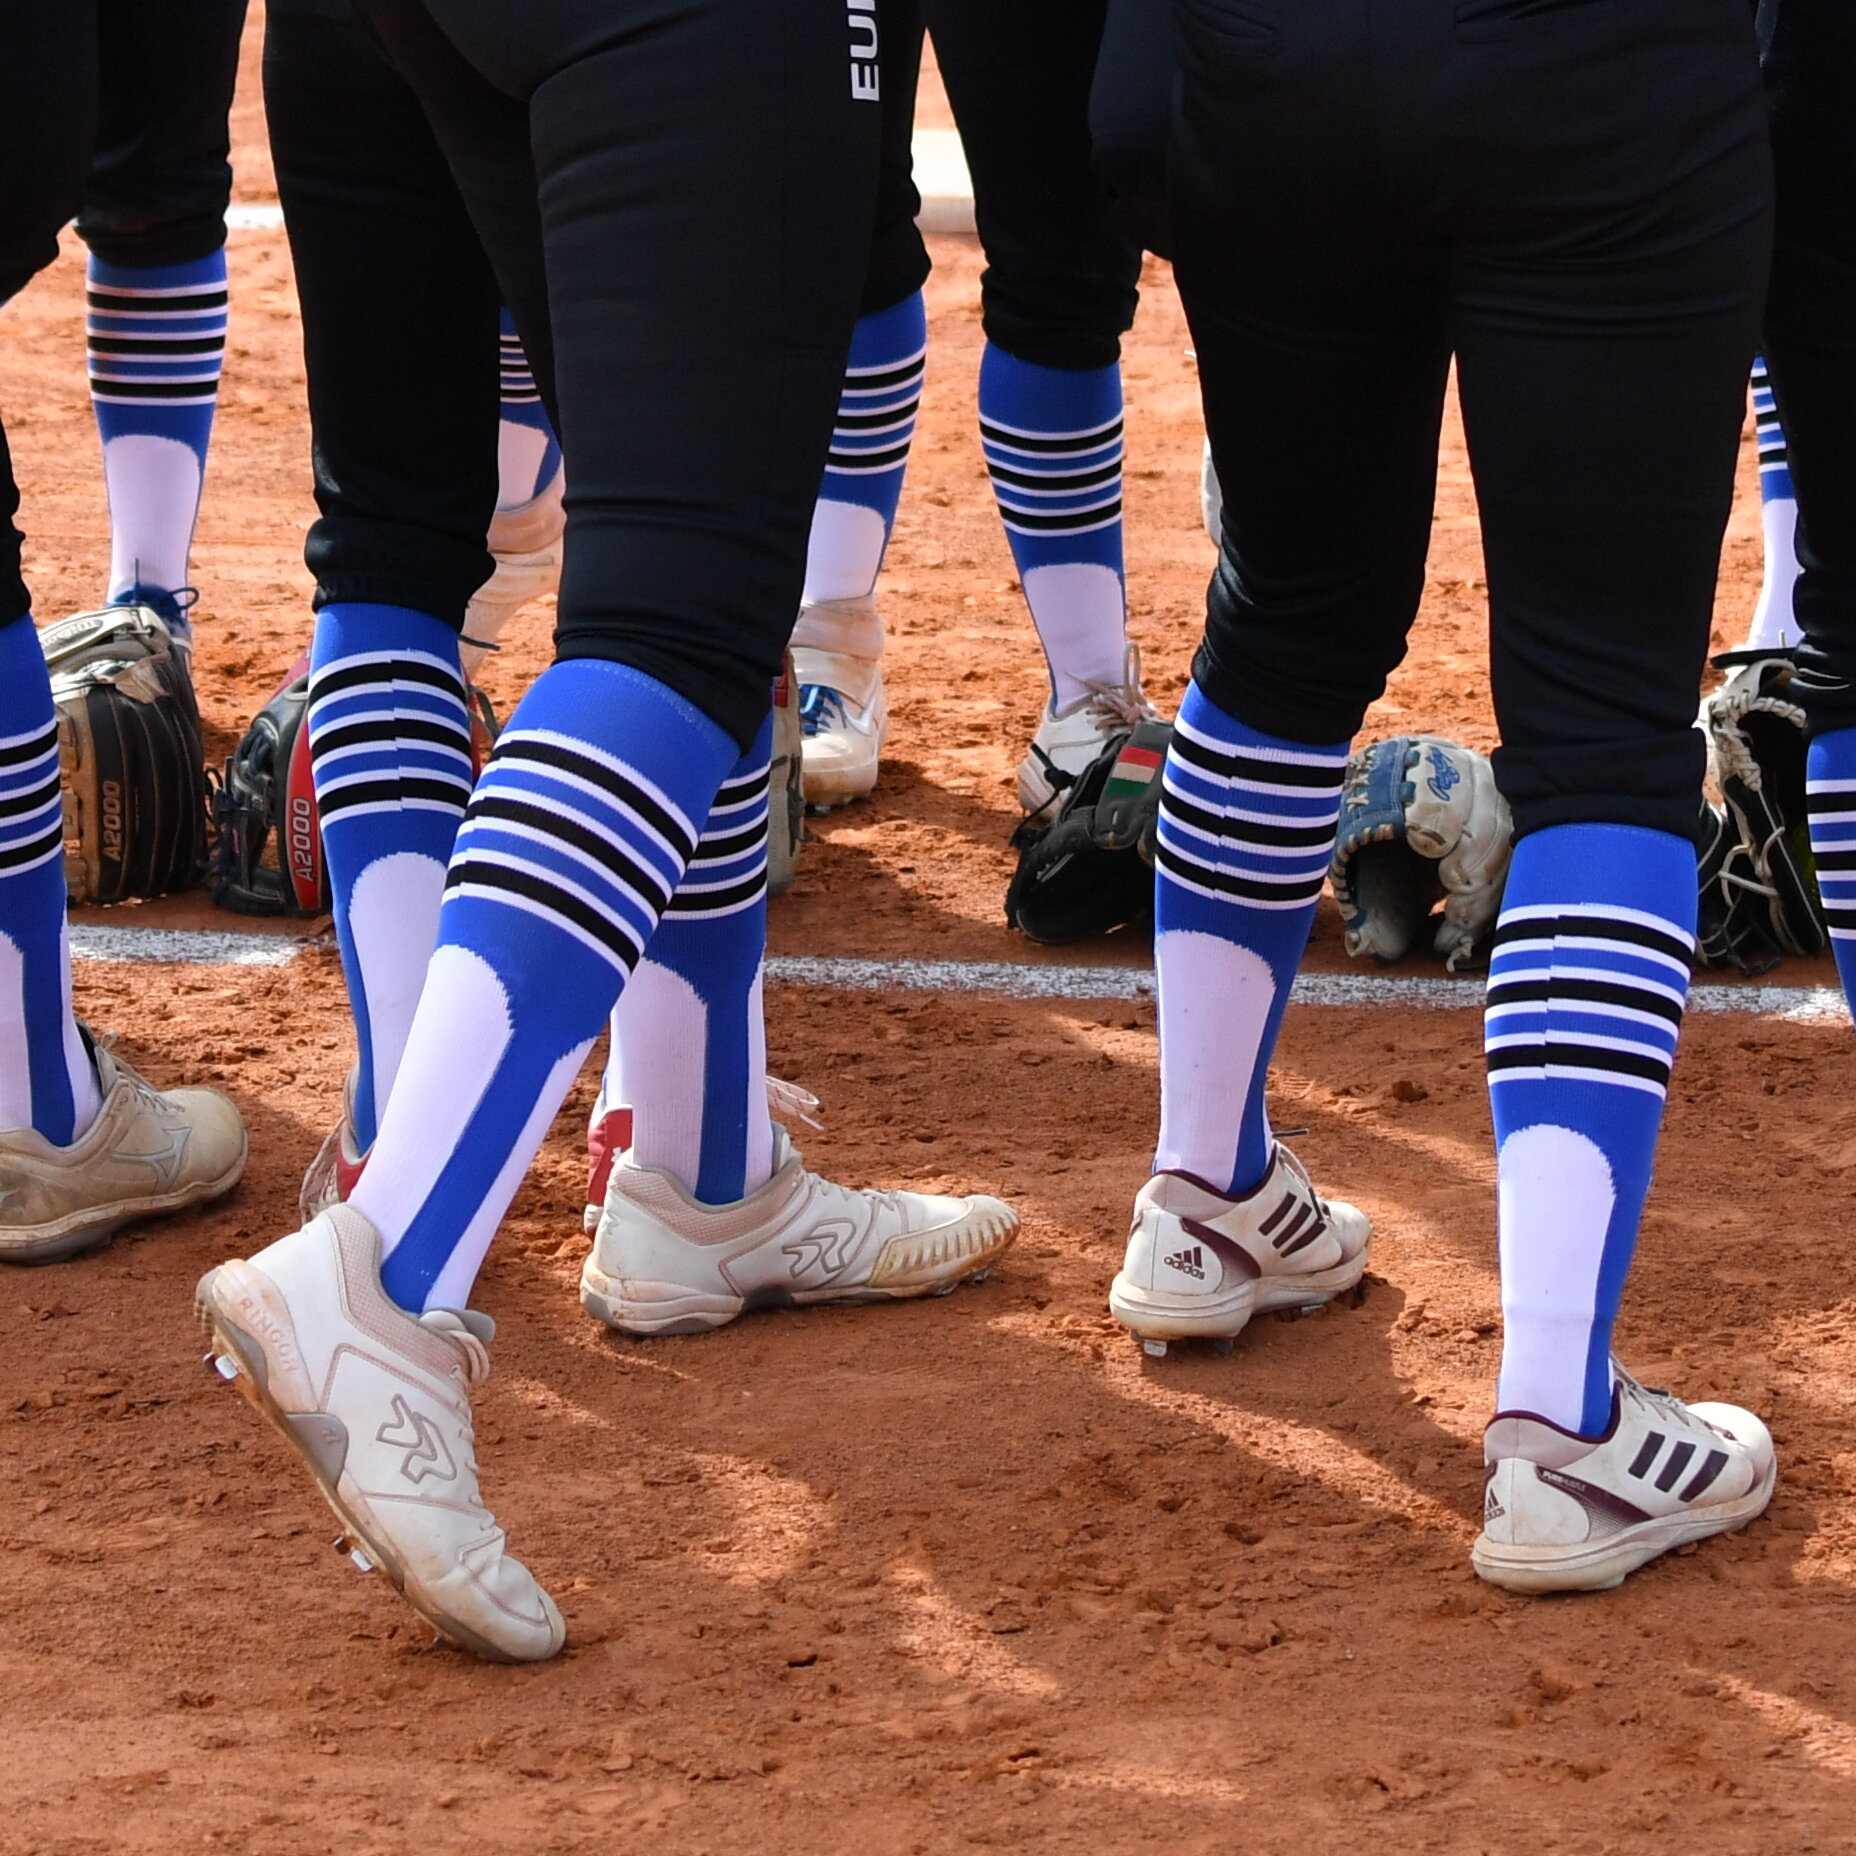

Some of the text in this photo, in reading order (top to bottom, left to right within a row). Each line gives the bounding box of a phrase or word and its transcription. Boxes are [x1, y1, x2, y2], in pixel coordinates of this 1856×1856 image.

[102, 780, 122, 862] A2000
[292, 797, 314, 883] A2000
[1163, 1256, 1206, 1281] adidas
